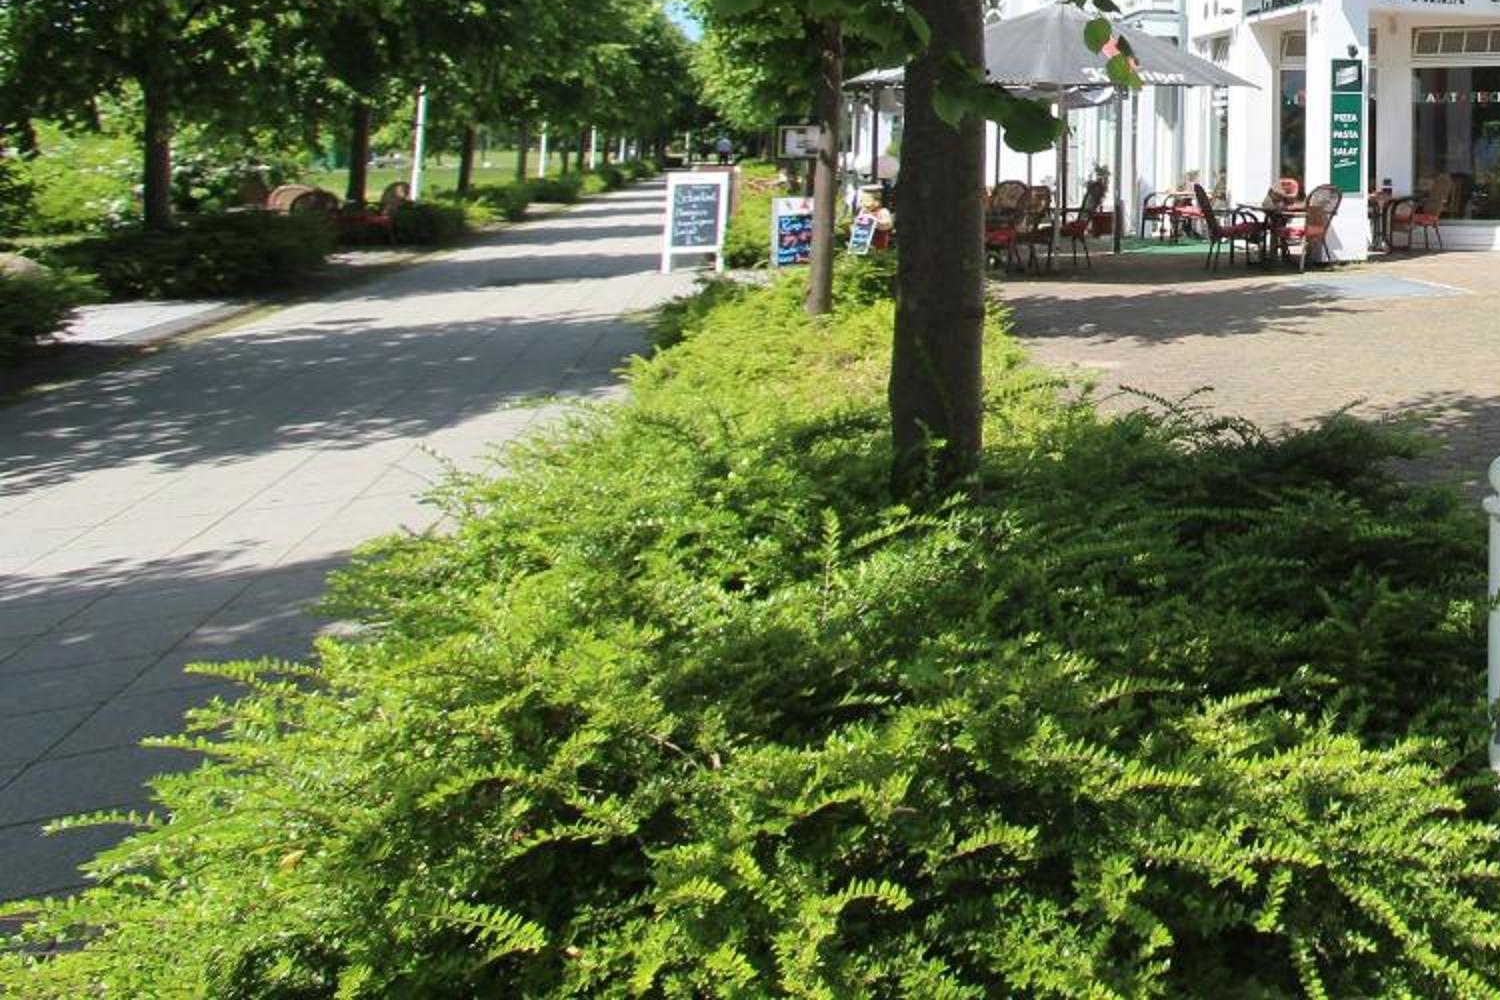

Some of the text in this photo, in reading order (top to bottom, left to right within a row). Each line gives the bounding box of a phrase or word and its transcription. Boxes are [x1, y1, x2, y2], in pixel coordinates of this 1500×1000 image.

[1333, 113, 1358, 123] PIZZA
[1333, 130, 1359, 139] PASTA
[1333, 146, 1359, 157] SALAT
